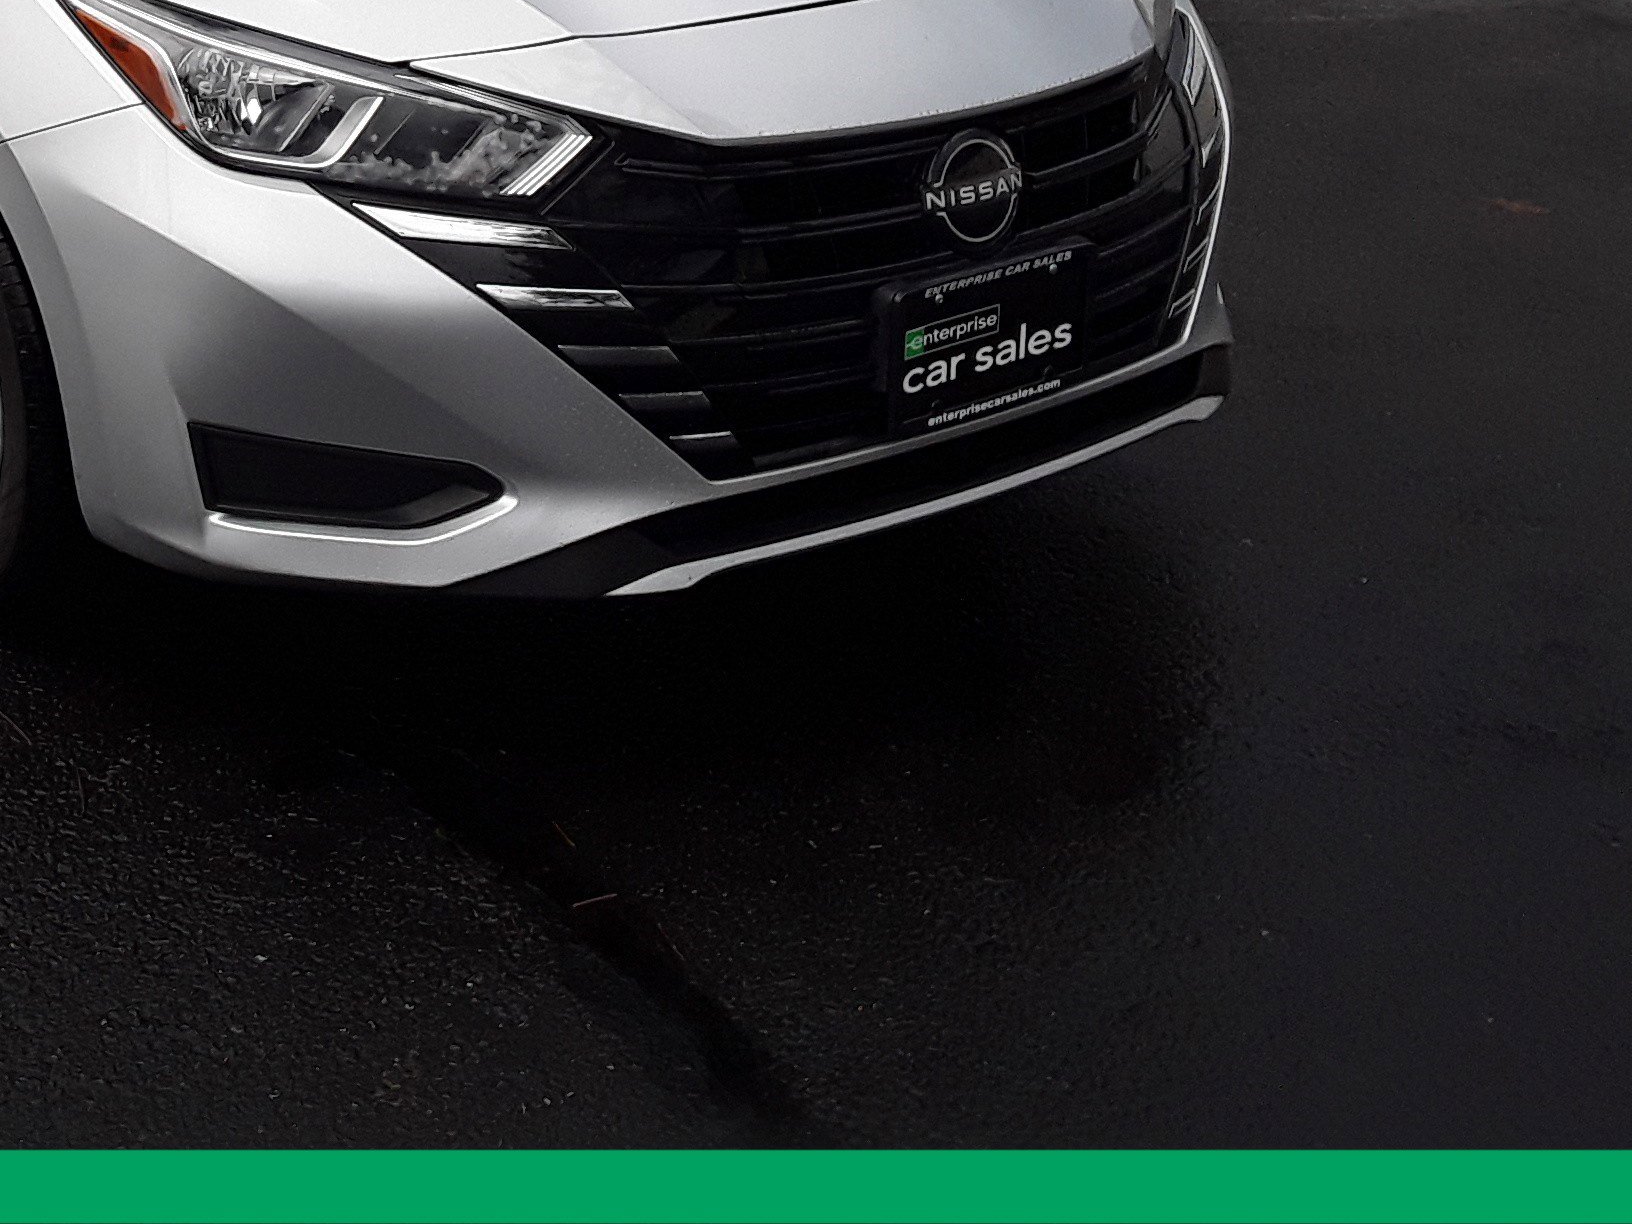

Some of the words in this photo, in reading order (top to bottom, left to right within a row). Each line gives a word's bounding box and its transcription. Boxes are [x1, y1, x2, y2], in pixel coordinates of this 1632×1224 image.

[926, 170, 1022, 210] NISSAN
[925, 269, 1003, 298] ENTERPRISE
[1005, 261, 1030, 276] CAR
[1033, 250, 1072, 269] SALES
[908, 313, 998, 350] enterprise
[902, 352, 966, 394] car
[974, 322, 1073, 372] sales
[927, 378, 1061, 426] enterprisecarsales.com
